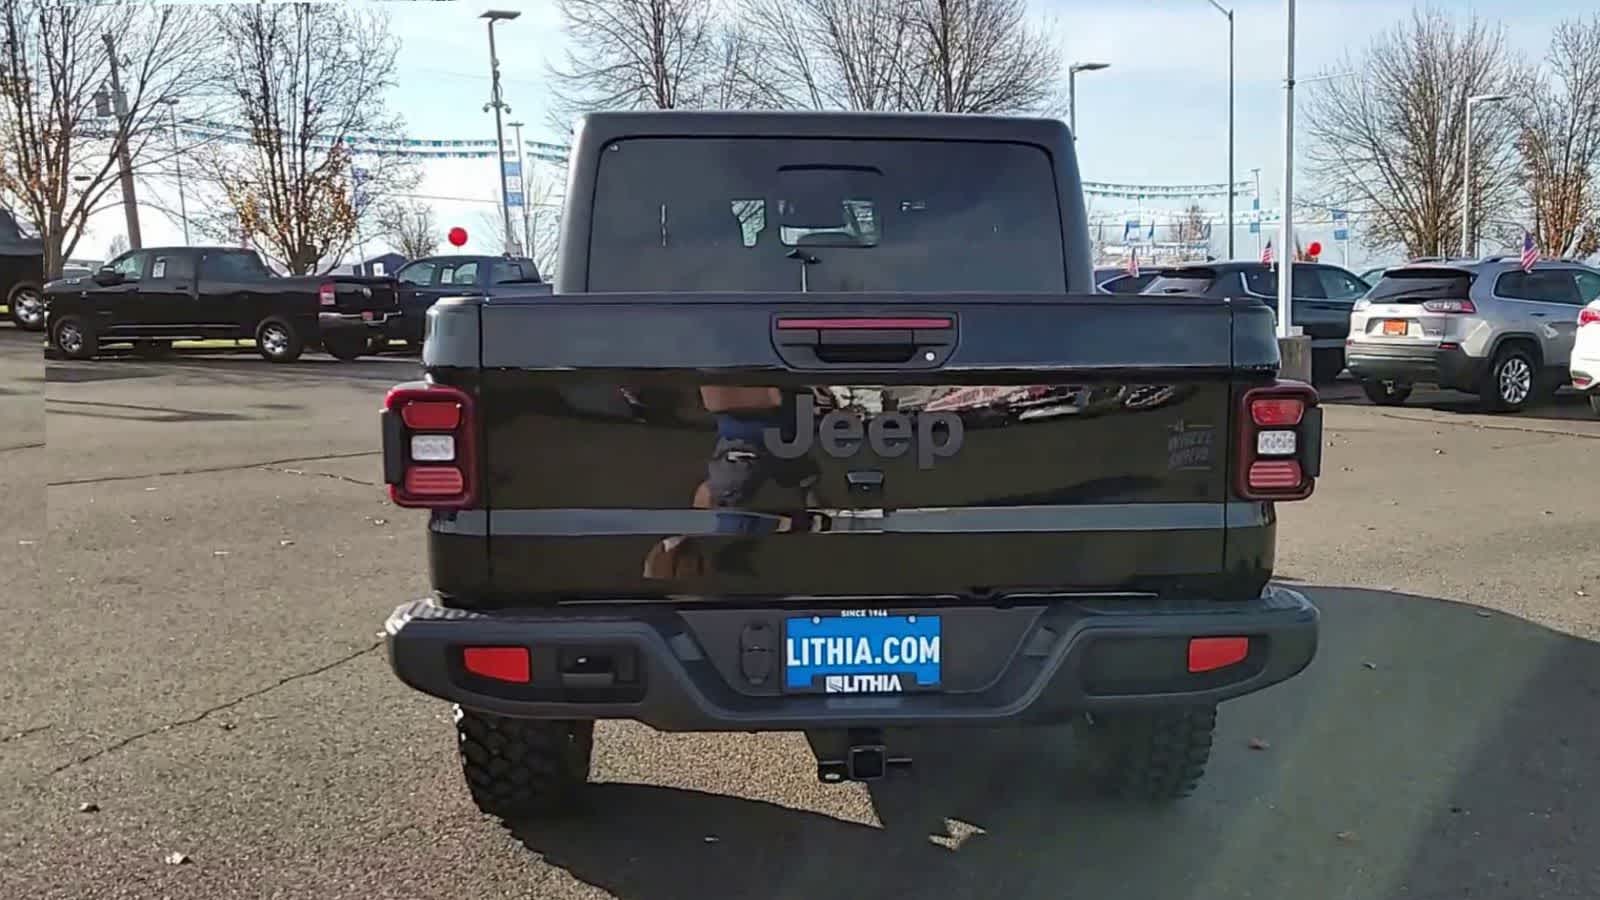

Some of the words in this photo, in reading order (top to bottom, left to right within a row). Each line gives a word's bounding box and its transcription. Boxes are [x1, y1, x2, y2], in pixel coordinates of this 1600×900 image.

[763, 394, 964, 470] Jeep
[841, 609, 866, 617] SINCE
[787, 636, 941, 667] LITHIA.COM
[843, 674, 902, 692] LITHIA
